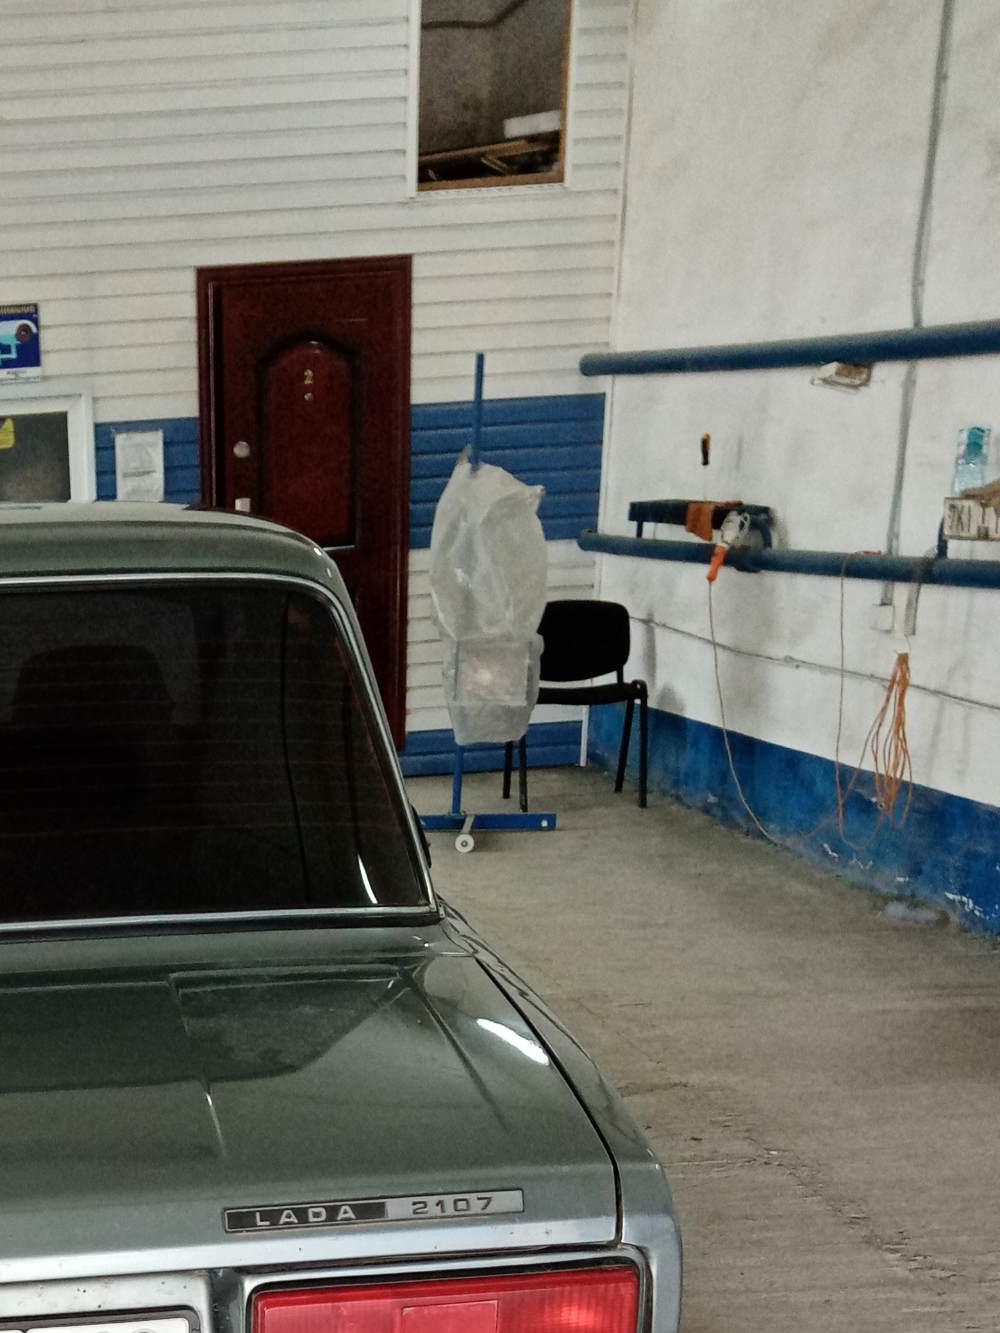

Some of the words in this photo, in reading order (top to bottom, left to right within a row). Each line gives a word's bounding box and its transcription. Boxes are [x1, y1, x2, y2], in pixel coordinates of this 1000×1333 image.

[304, 369, 313, 385] 2
[255, 1205, 356, 1226] LADA
[412, 1196, 494, 1215] 2107
